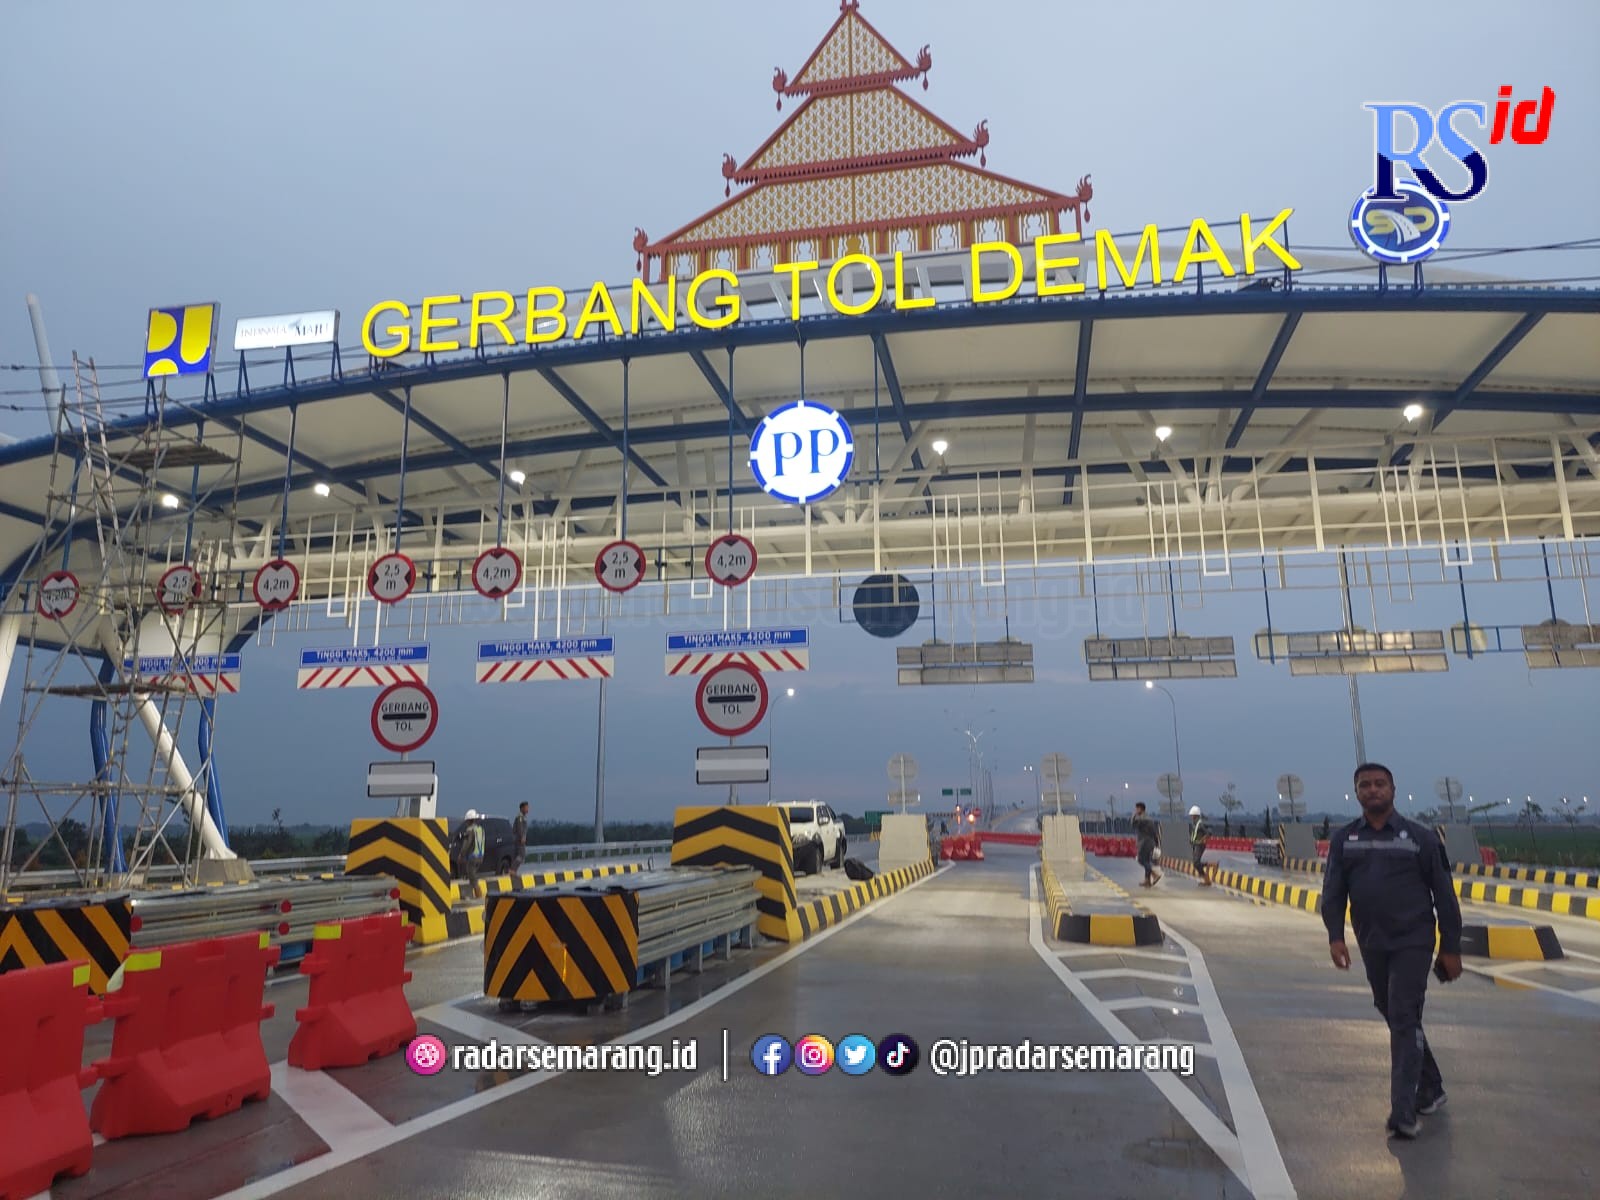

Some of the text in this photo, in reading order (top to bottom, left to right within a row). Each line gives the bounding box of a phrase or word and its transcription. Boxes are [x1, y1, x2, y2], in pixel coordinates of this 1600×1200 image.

[361, 209, 1301, 357] GERBANG TOL DEMAK
[771, 428, 839, 477] PP
[611, 551, 629, 566] 2,5
[716, 553, 747, 568] 4,2m
[384, 564, 401, 578] 2,5
[482, 565, 511, 580] 4,2m
[614, 567, 626, 579] m
[172, 575, 188, 589] 2,5
[263, 577, 290, 591] 4,2m
[385, 580, 397, 591] m
[555, 639, 579, 650] 4200
[580, 638, 597, 649] mm
[683, 633, 715, 645] TINGGI
[747, 630, 772, 641] 4200
[774, 630, 791, 640] mm
[373, 647, 396, 657] 4200
[398, 646, 414, 656] mm
[705, 683, 757, 696] GERBANG
[381, 701, 429, 714] GERBANG
[722, 703, 742, 716] TOL
[394, 720, 414, 732] TOL
